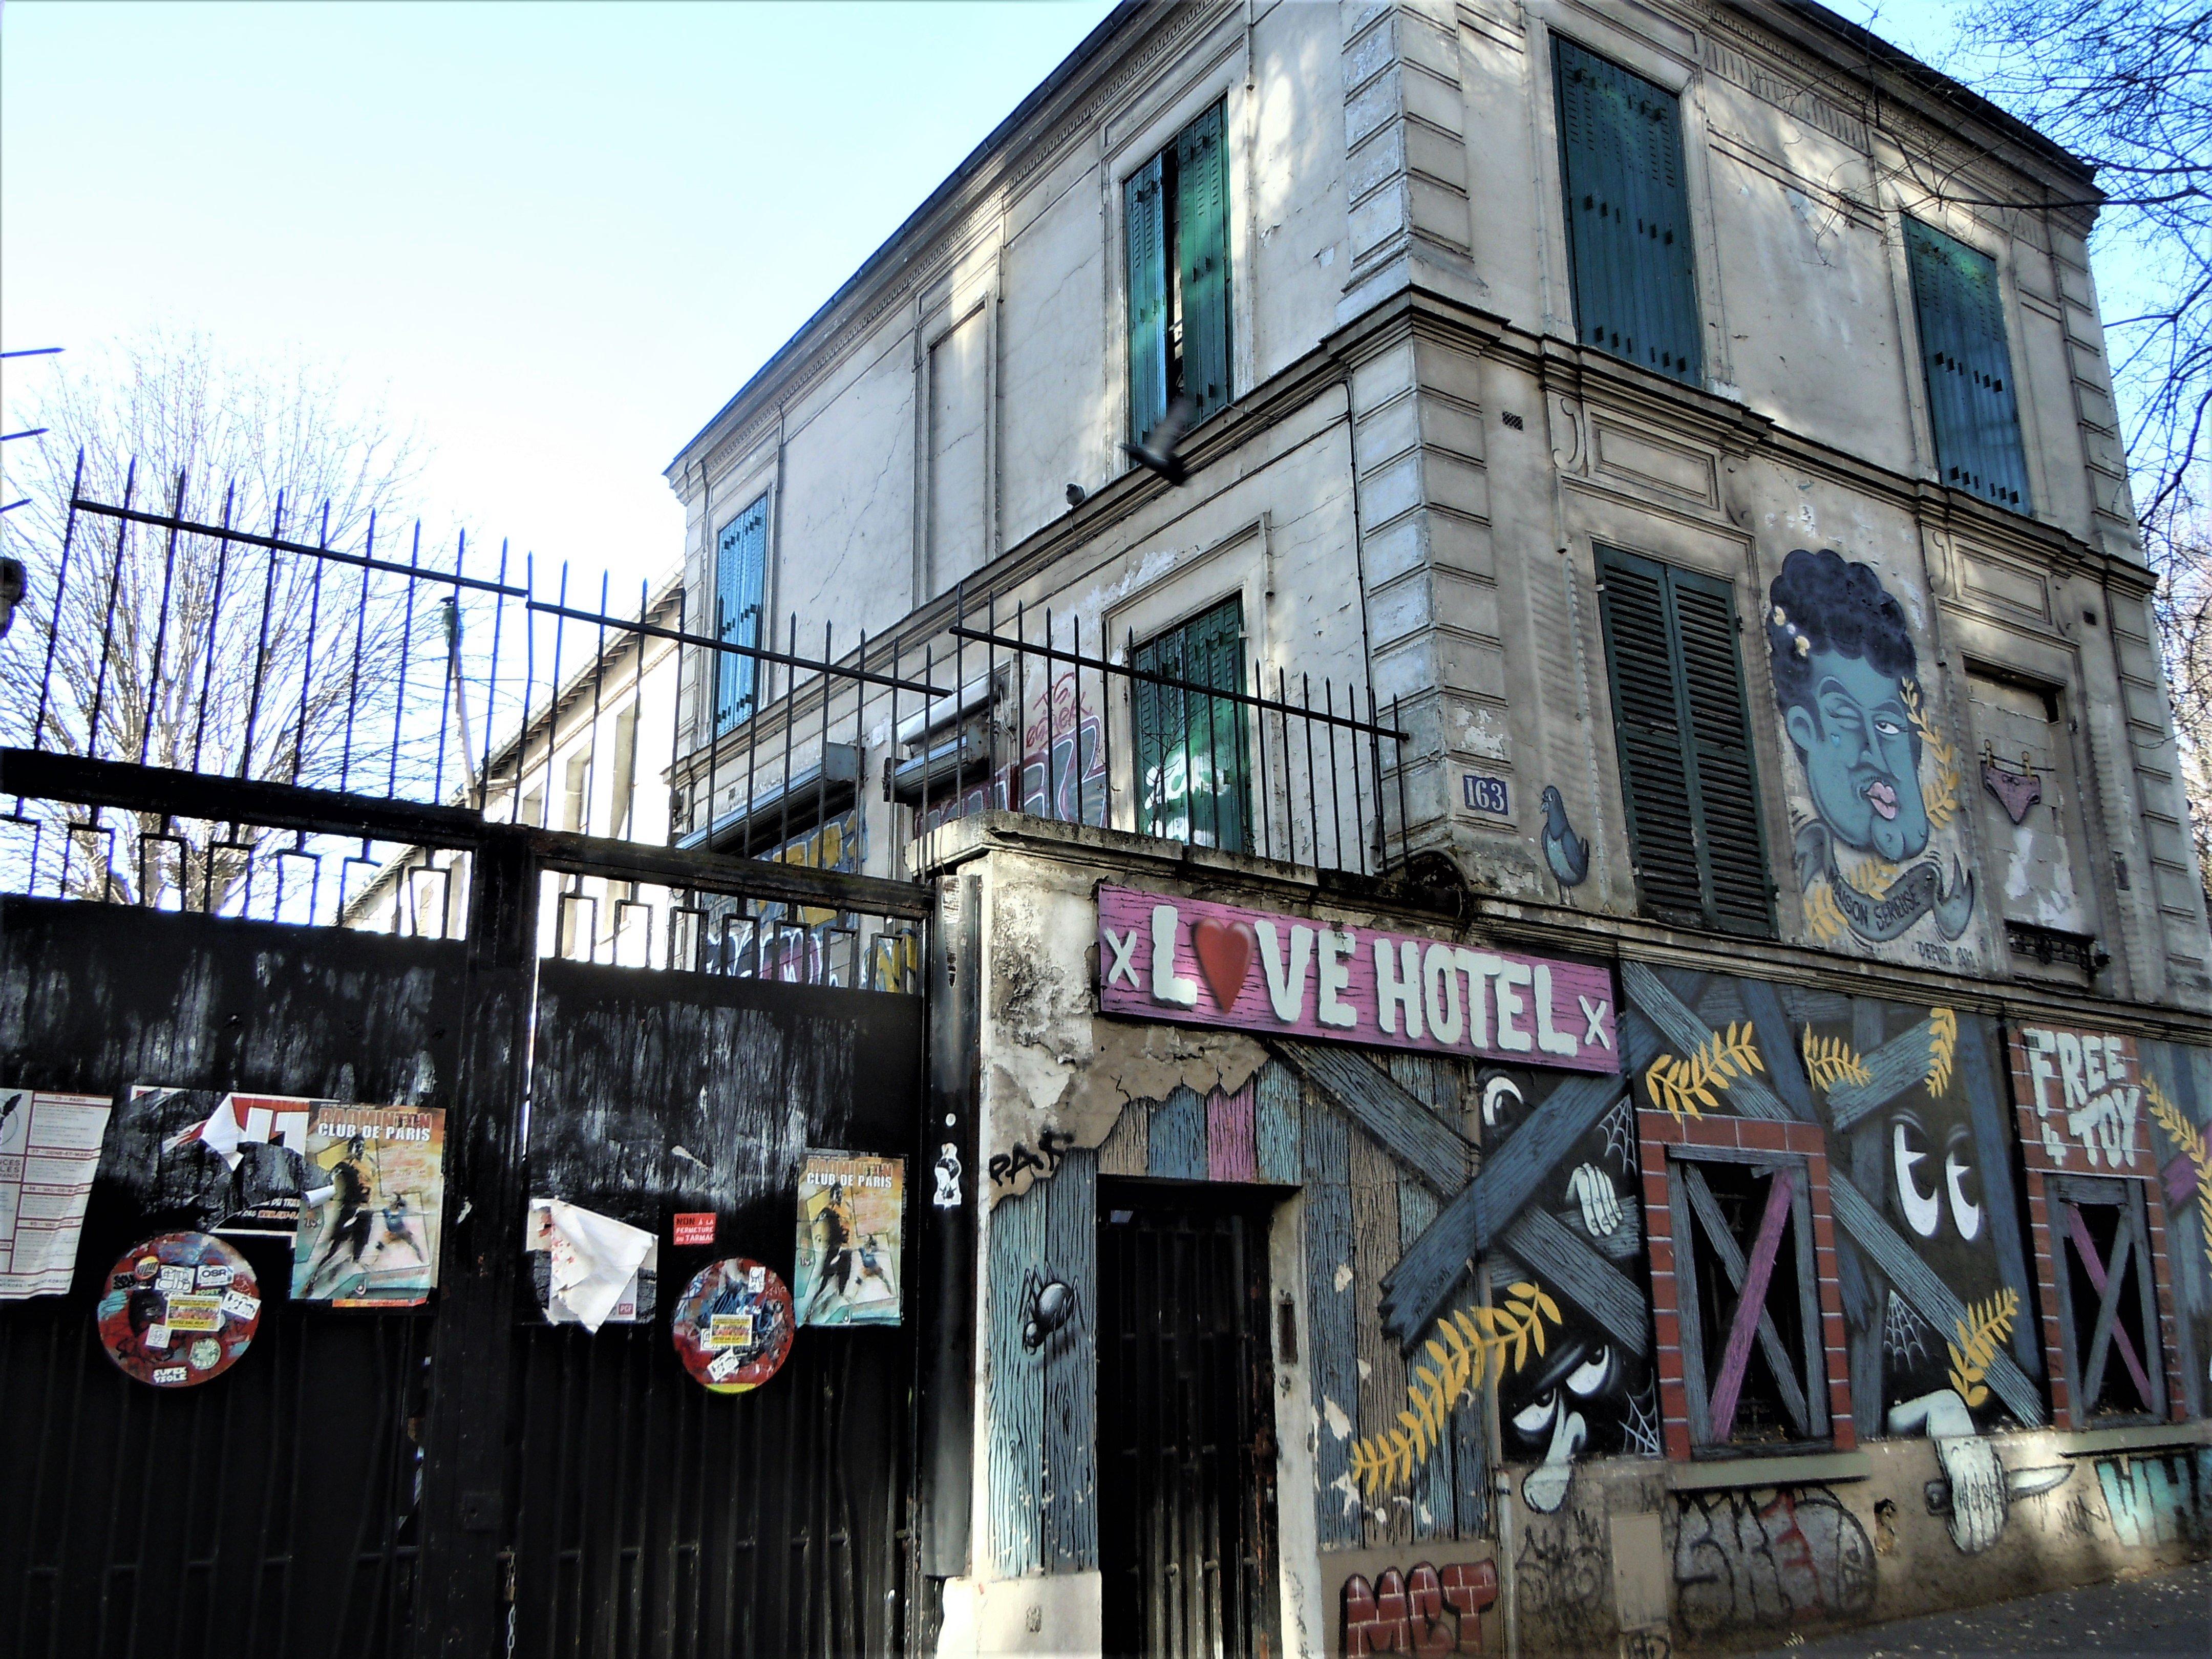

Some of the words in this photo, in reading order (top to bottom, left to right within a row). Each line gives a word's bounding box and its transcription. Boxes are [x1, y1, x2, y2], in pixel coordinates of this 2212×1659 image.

[1466, 777, 1504, 811] 163
[1373, 937, 1578, 1057] HOTEL
[2023, 1027, 2126, 1118] FREE
[318, 1123, 356, 1138] CLUB
[362, 1125, 380, 1139] DE
[386, 1126, 432, 1142] PARIS
[2068, 1087, 2140, 1168] TOY
[807, 1173, 836, 1186] CLUB
[840, 1174, 854, 1186] DE
[858, 1175, 892, 1188] PARIS
